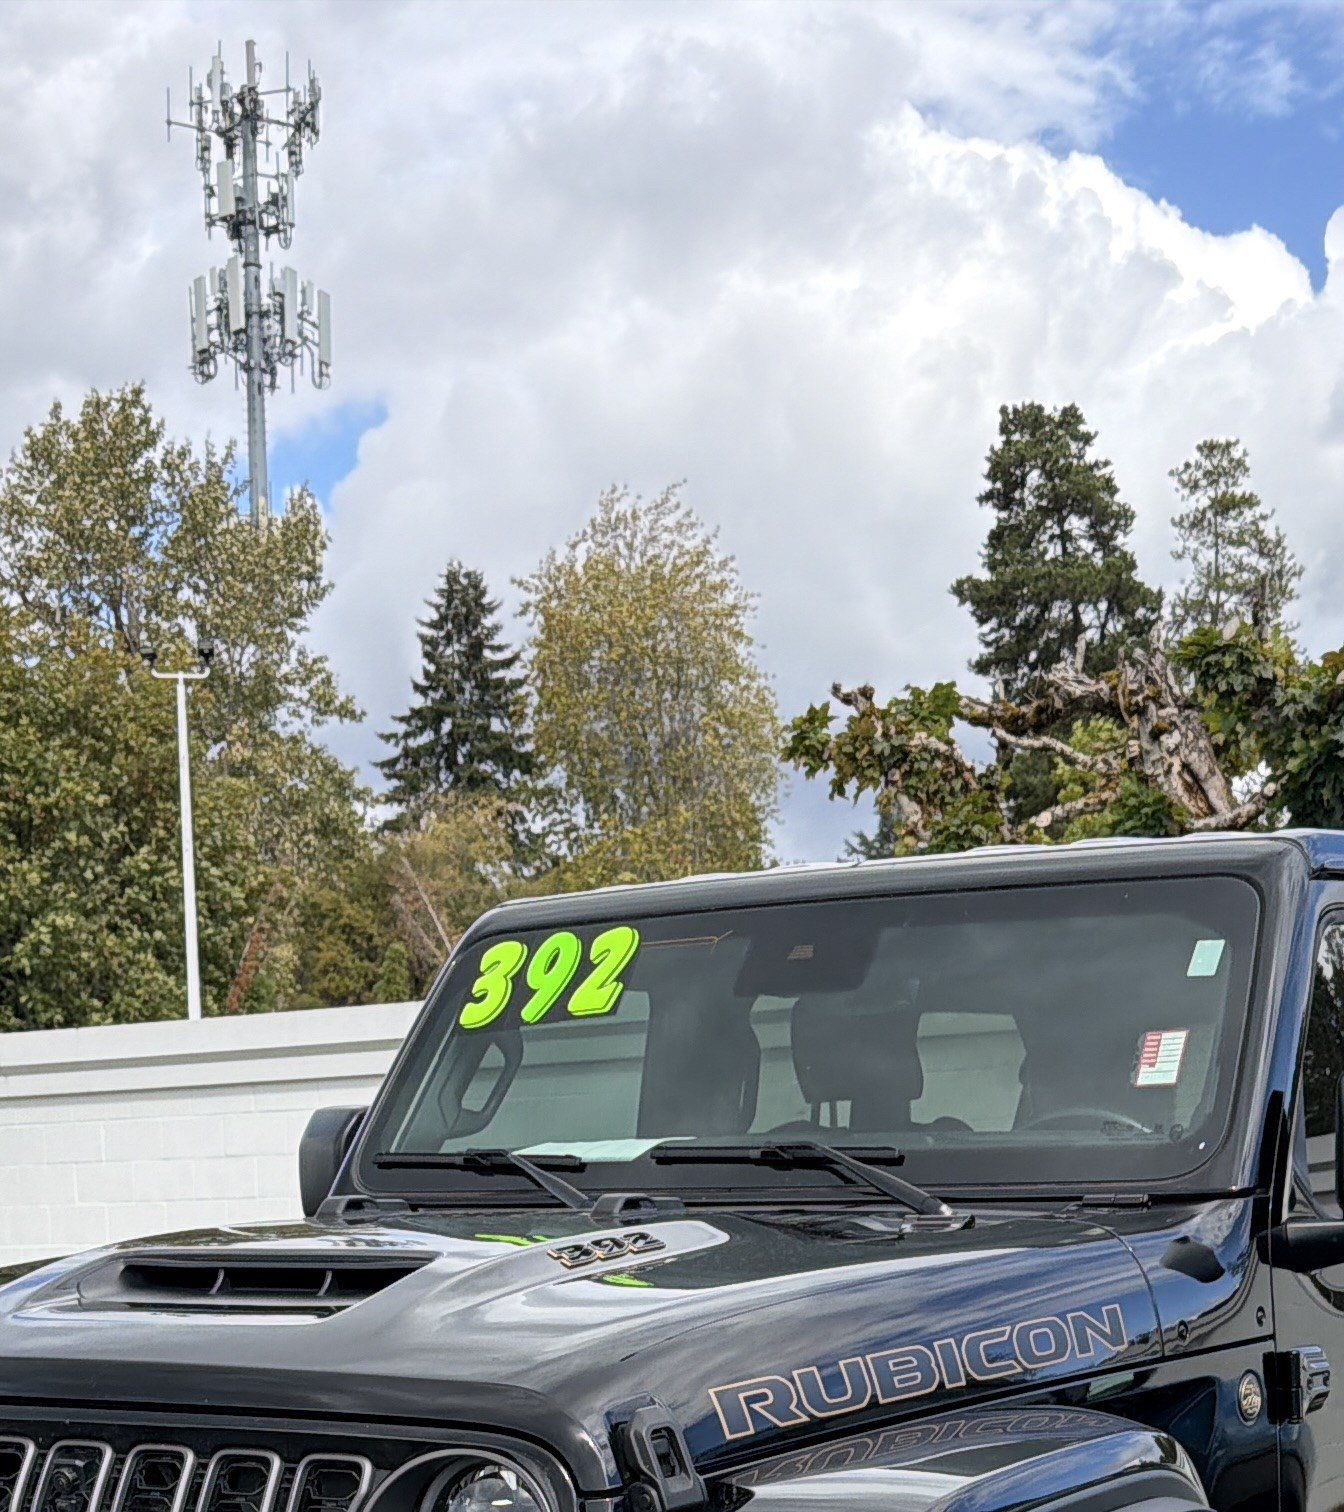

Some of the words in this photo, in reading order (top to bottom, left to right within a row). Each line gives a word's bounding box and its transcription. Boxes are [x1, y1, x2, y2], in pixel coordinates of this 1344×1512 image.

[459, 926, 640, 1029] 392
[546, 1231, 667, 1270] 392
[709, 1303, 1129, 1441] RUBICON
